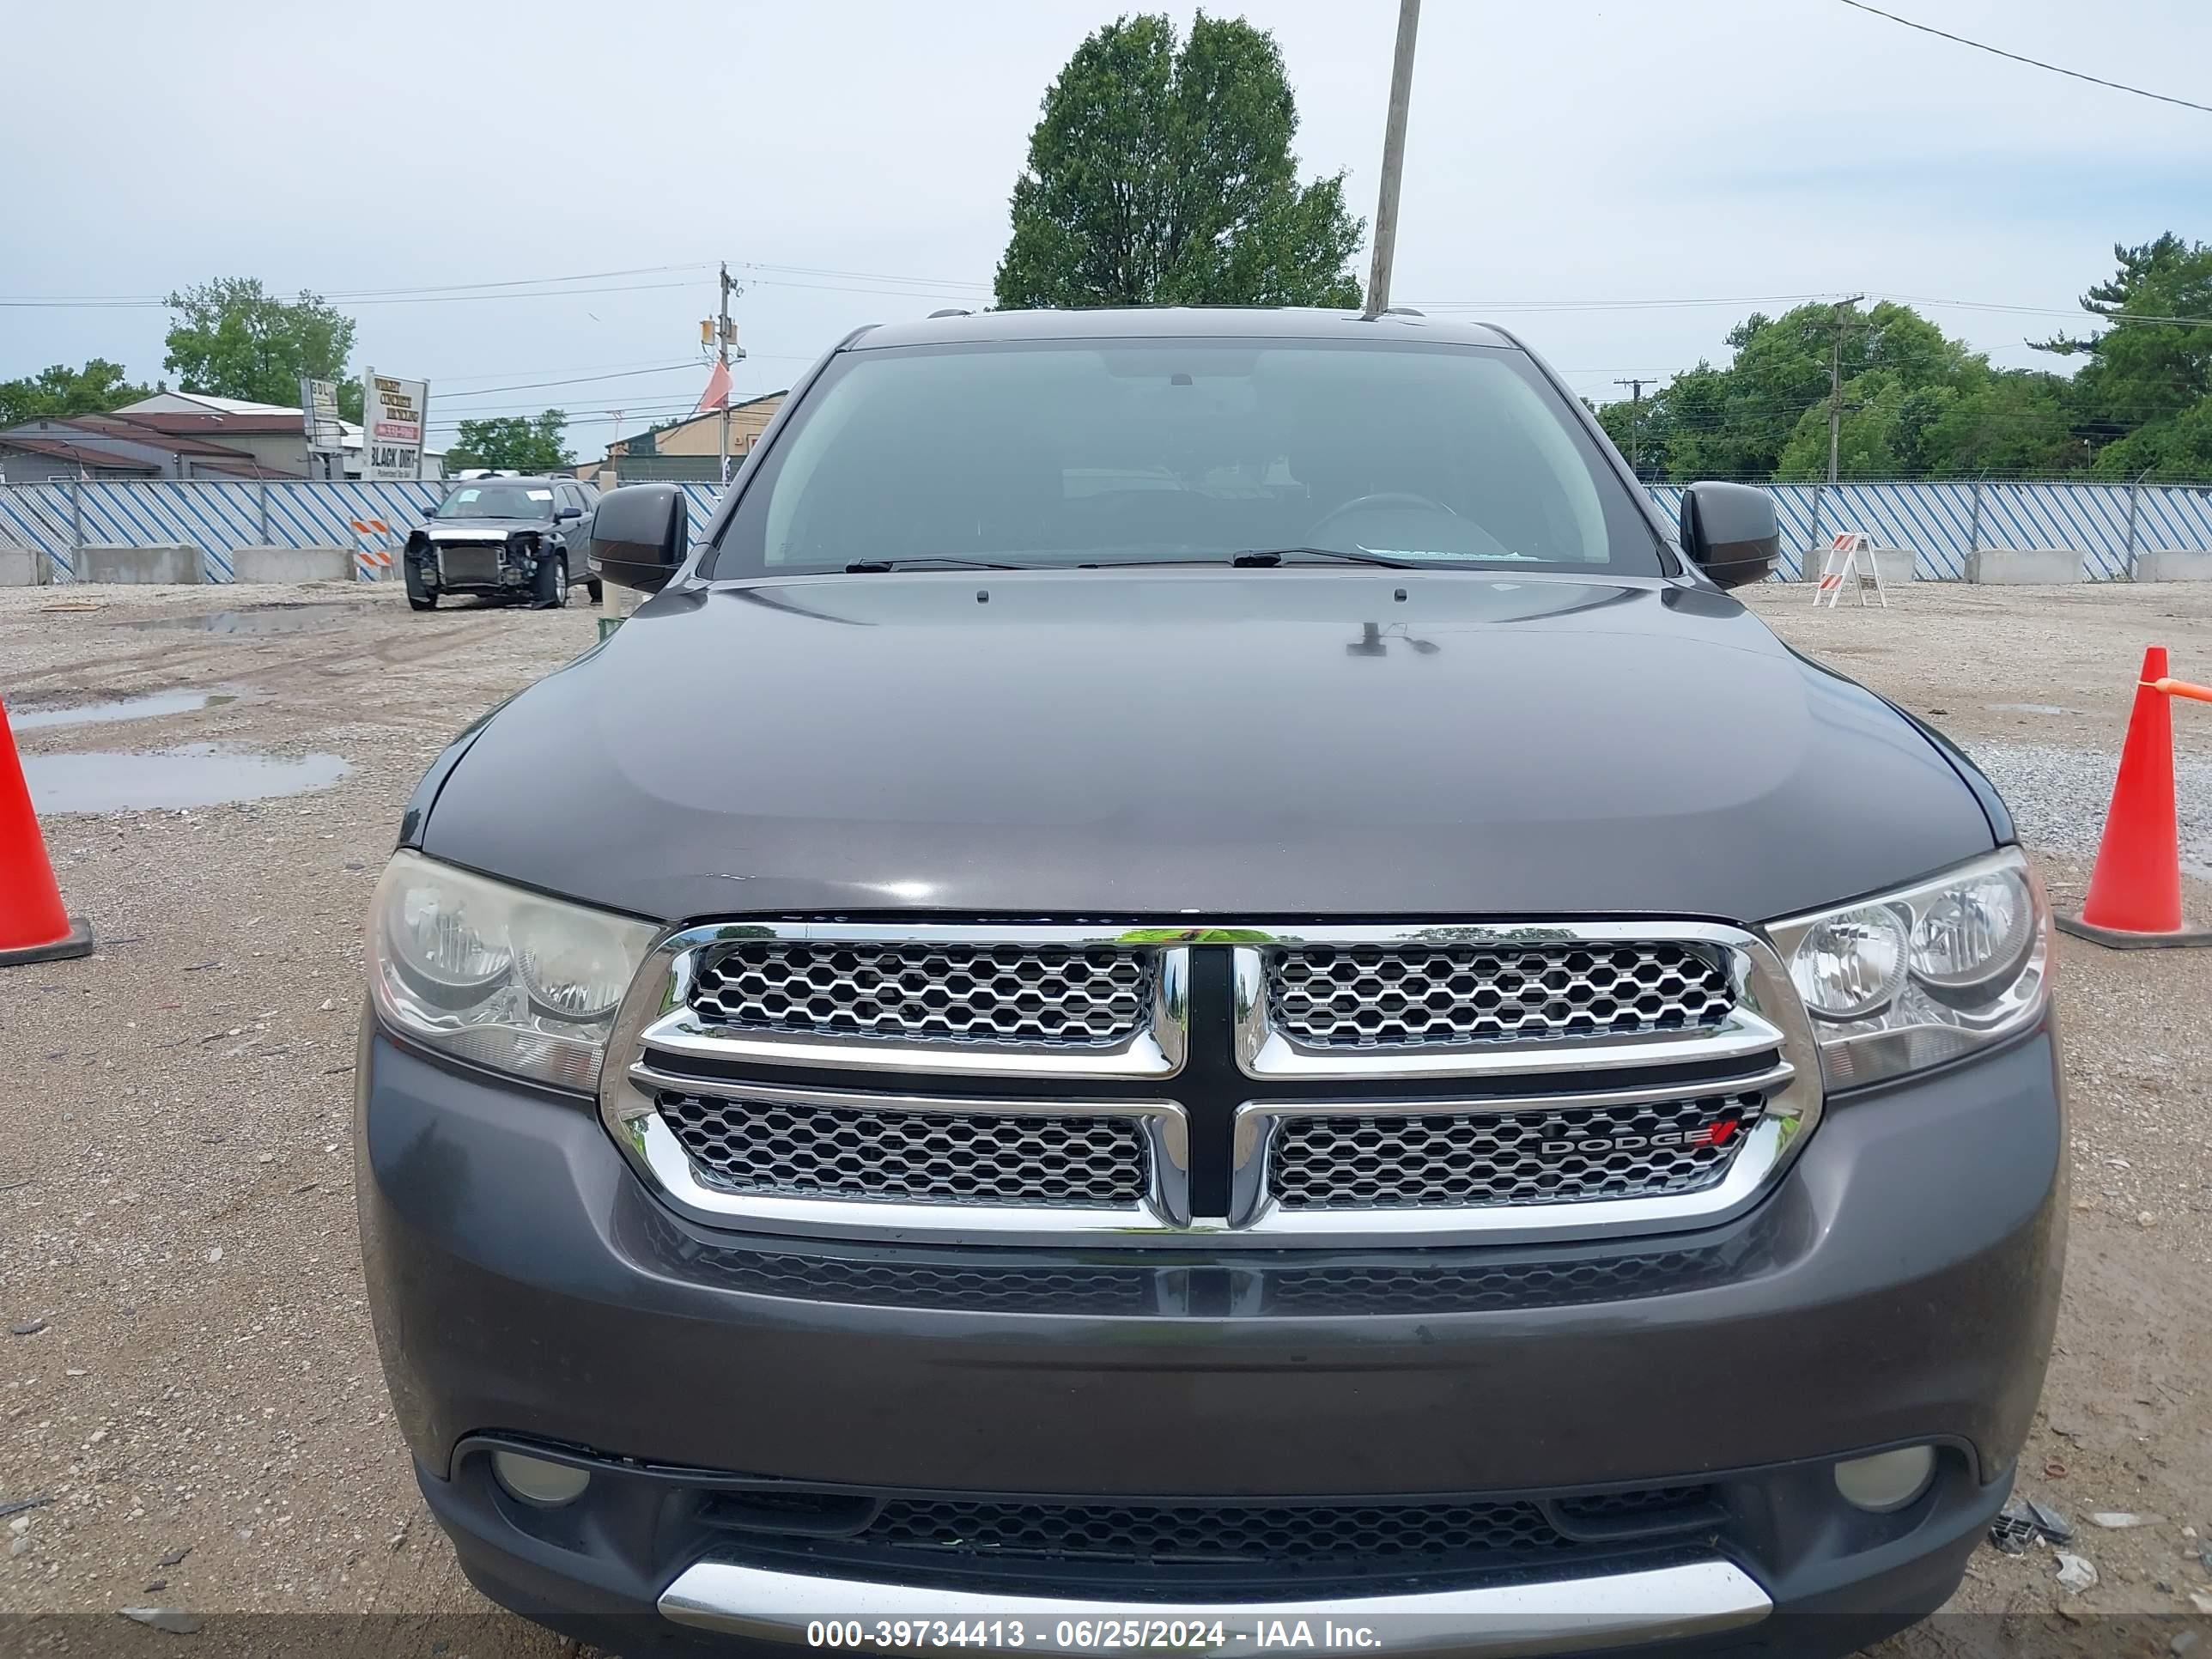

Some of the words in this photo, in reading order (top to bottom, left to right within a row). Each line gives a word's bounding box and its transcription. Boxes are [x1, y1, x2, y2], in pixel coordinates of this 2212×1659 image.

[371, 447, 397, 468] BLACK
[399, 448, 416, 469] DIRT
[1541, 1128, 1713, 1155] DODGE
